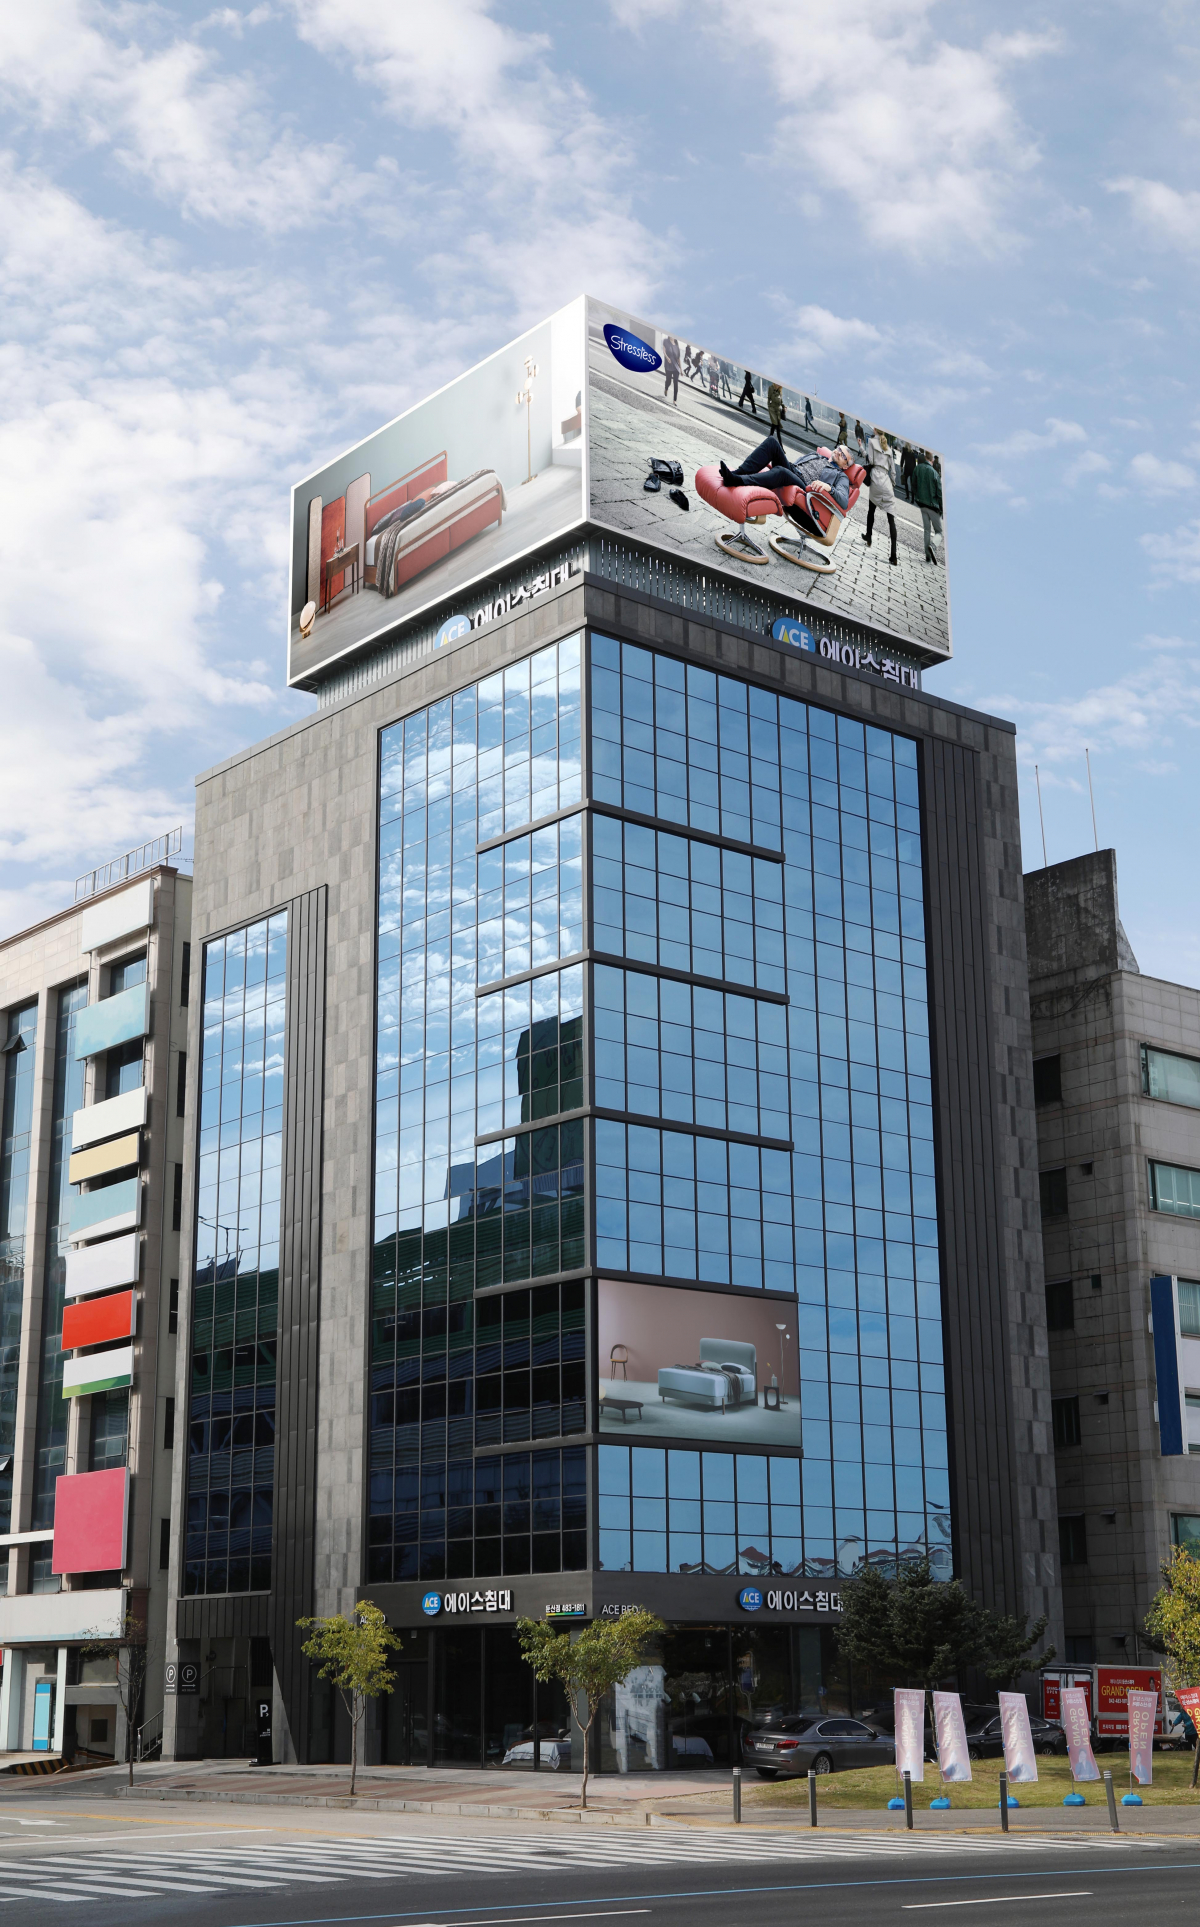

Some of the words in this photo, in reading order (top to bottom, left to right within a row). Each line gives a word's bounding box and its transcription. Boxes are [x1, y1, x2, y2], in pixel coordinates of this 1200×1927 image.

[610, 335, 657, 365] Stressless
[440, 621, 465, 646] ACE
[778, 625, 809, 651] ACE
[424, 1597, 438, 1608] ACE
[444, 1590, 511, 1613] 에이스침대
[743, 1593, 759, 1603] ACE
[601, 1604, 620, 1615] ACE
[1101, 1685, 1125, 1696] GRAND
[260, 1704, 269, 1717] P
